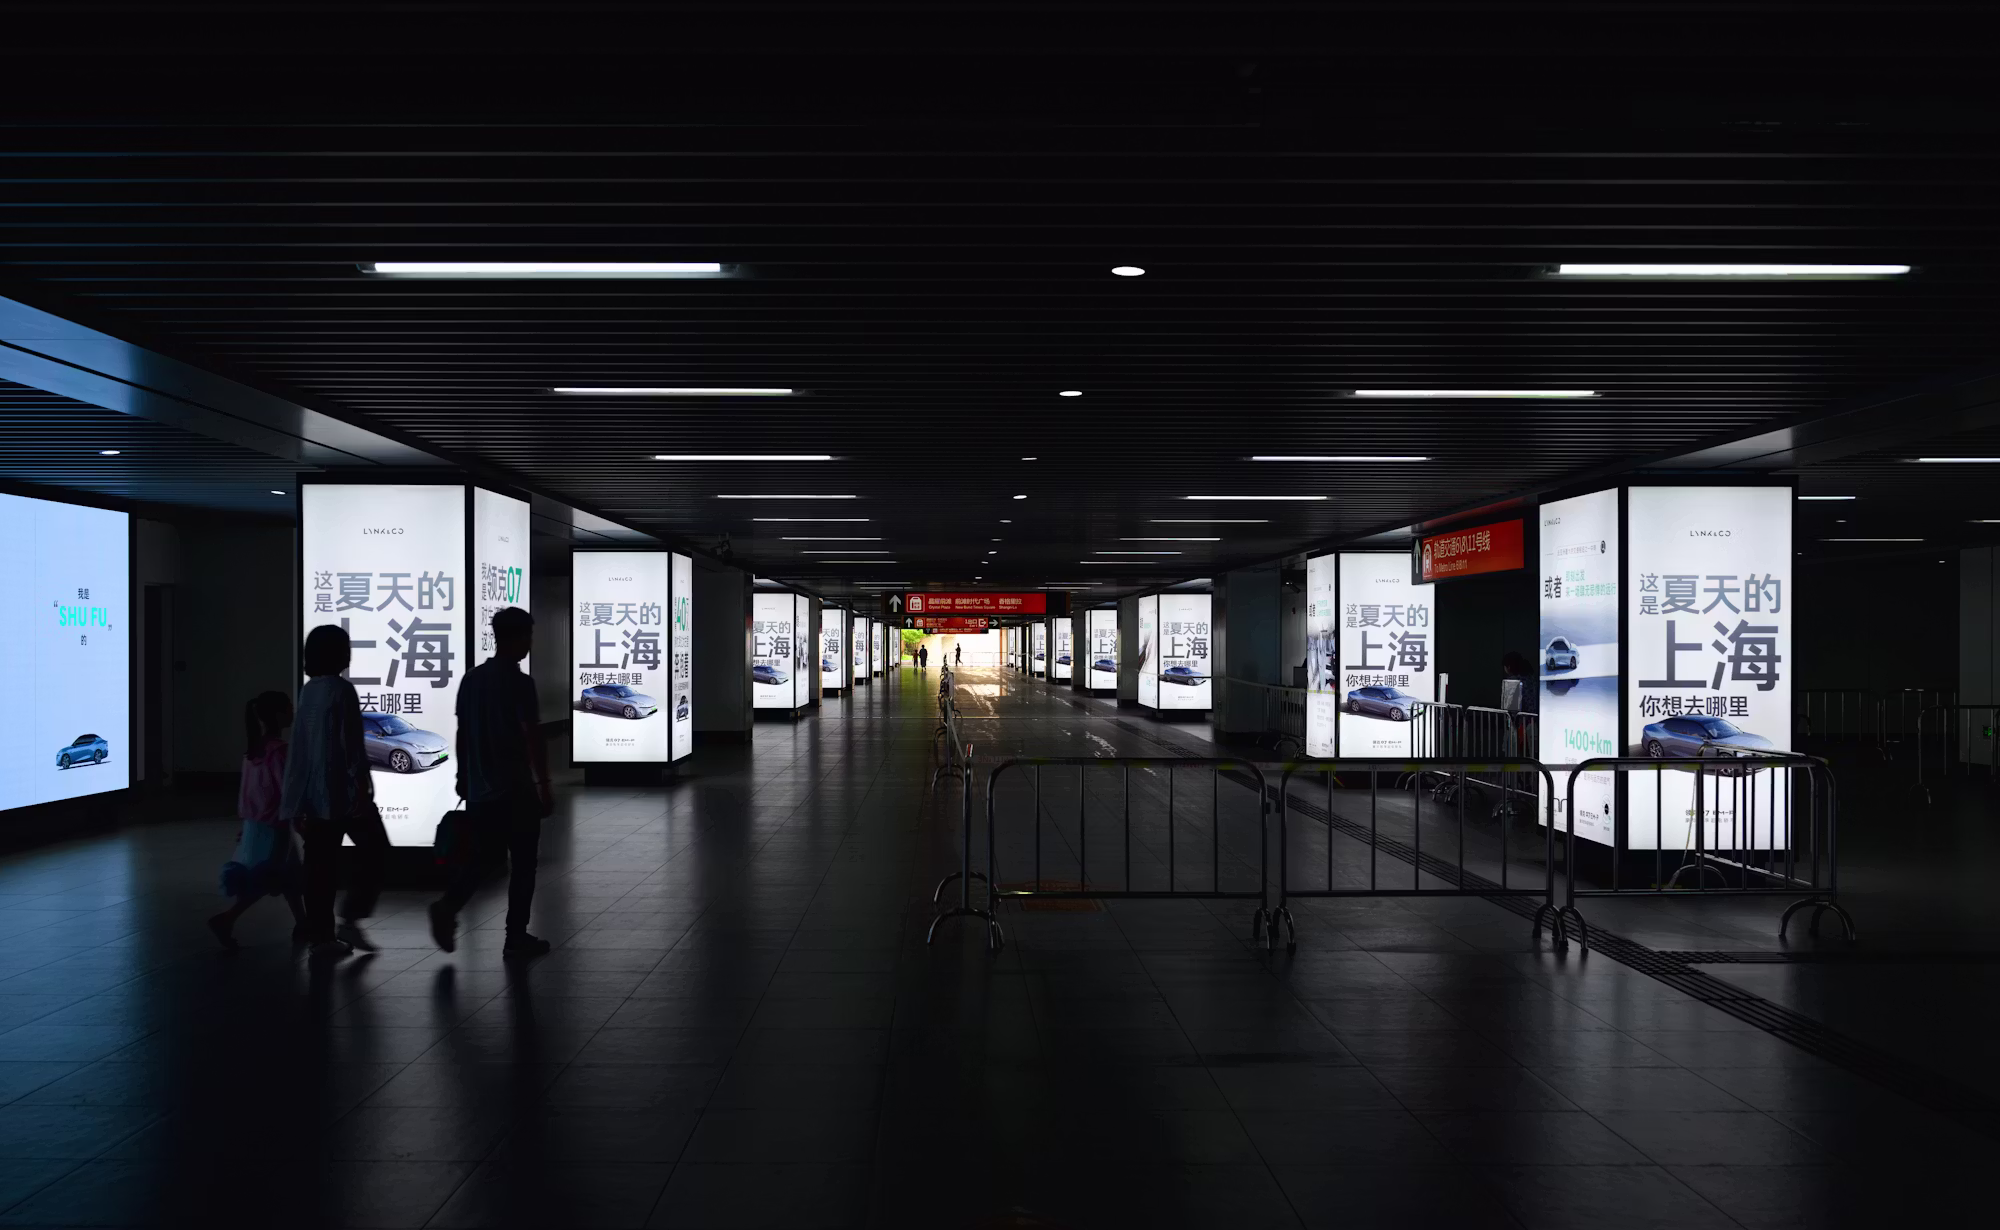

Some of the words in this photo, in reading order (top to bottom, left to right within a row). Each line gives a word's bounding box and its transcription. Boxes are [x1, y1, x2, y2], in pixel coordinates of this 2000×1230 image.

[78, 588, 89, 599] 我是
[335, 571, 455, 612] 夏天的
[1545, 576, 1562, 599] 或者
[1660, 573, 1782, 614] 夏天的
[592, 602, 661, 626] 夏天的
[1359, 604, 1428, 628] 夏天的
[81, 634, 87, 646] 的
[1170, 622, 1208, 635] 夏天的
[579, 629, 661, 670] 上海
[1163, 637, 1208, 659] 上海
[1345, 631, 1428, 672] 上海
[1638, 619, 1782, 691] 上海
[579, 672, 643, 686] 你想去哪里
[1345, 674, 1410, 687] 你想去哪里
[1639, 695, 1749, 717] 你想去哪里
[1565, 729, 1612, 755] 1400+km
